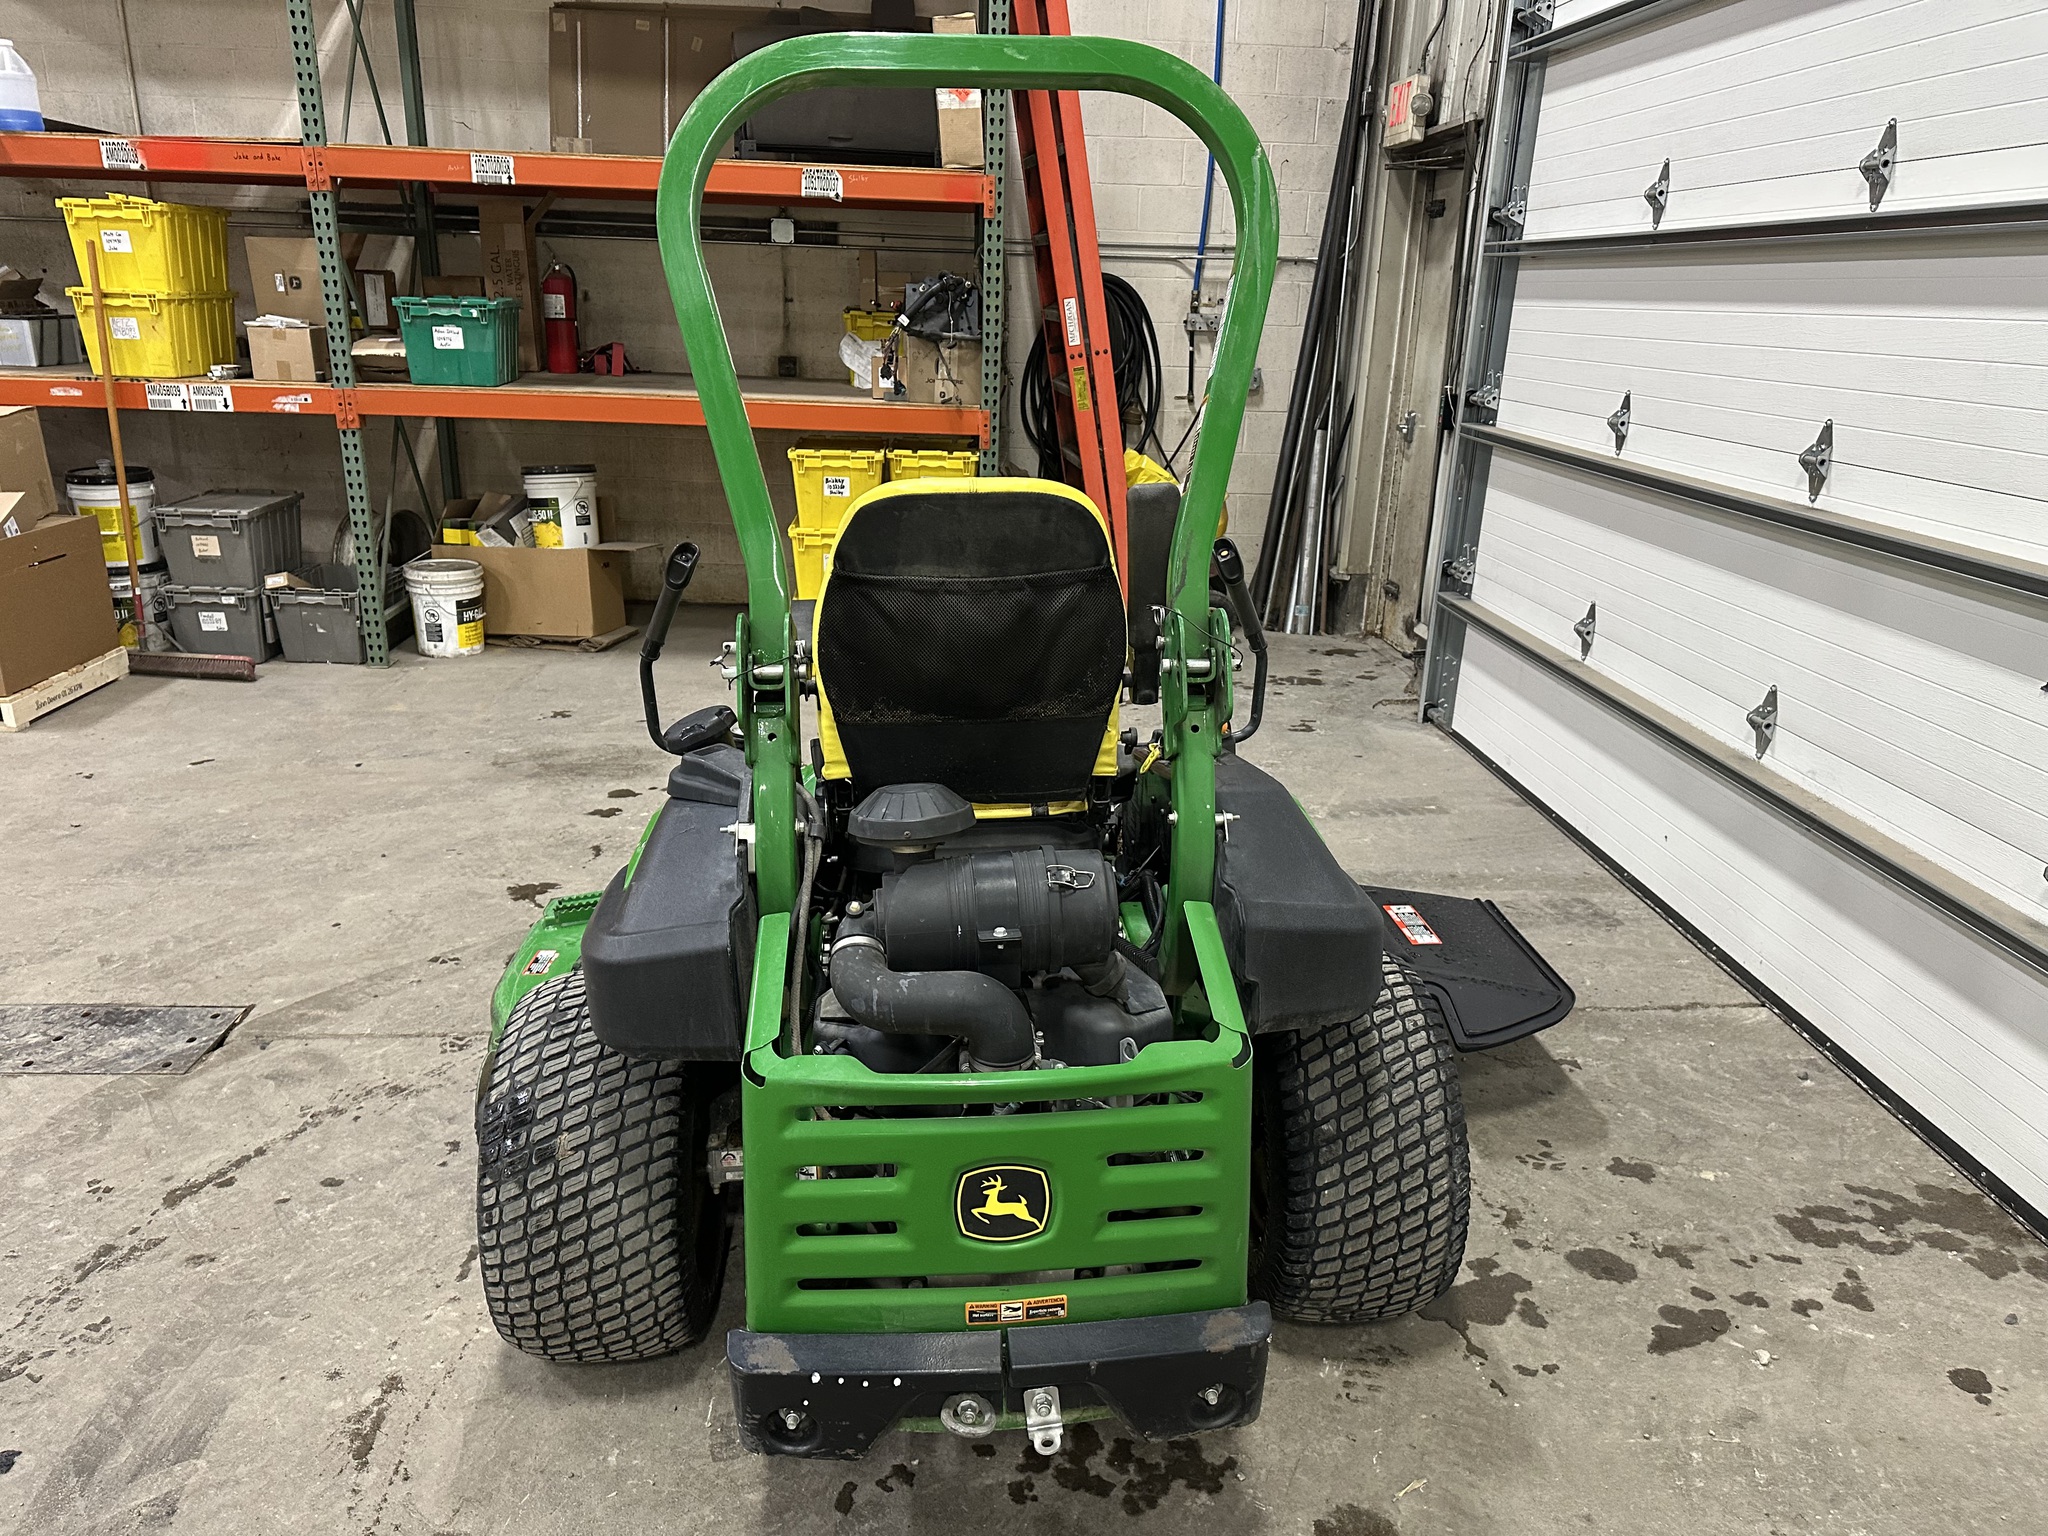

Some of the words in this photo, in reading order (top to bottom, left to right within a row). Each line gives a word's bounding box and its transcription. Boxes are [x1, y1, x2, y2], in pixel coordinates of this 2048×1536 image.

[1389, 80, 1412, 128] EXIT
[233, 150, 249, 160] Jake
[253, 152, 264, 160] and
[266, 152, 282, 162] Bake
[489, 244, 502, 274] GAL.
[505, 258, 513, 286] WATER
[192, 386, 224, 397] AM005A039
[35, 699, 48, 711] John
[46, 693, 61, 706] Deere
[1033, 1297, 1065, 1305] ADVERTENCIA
